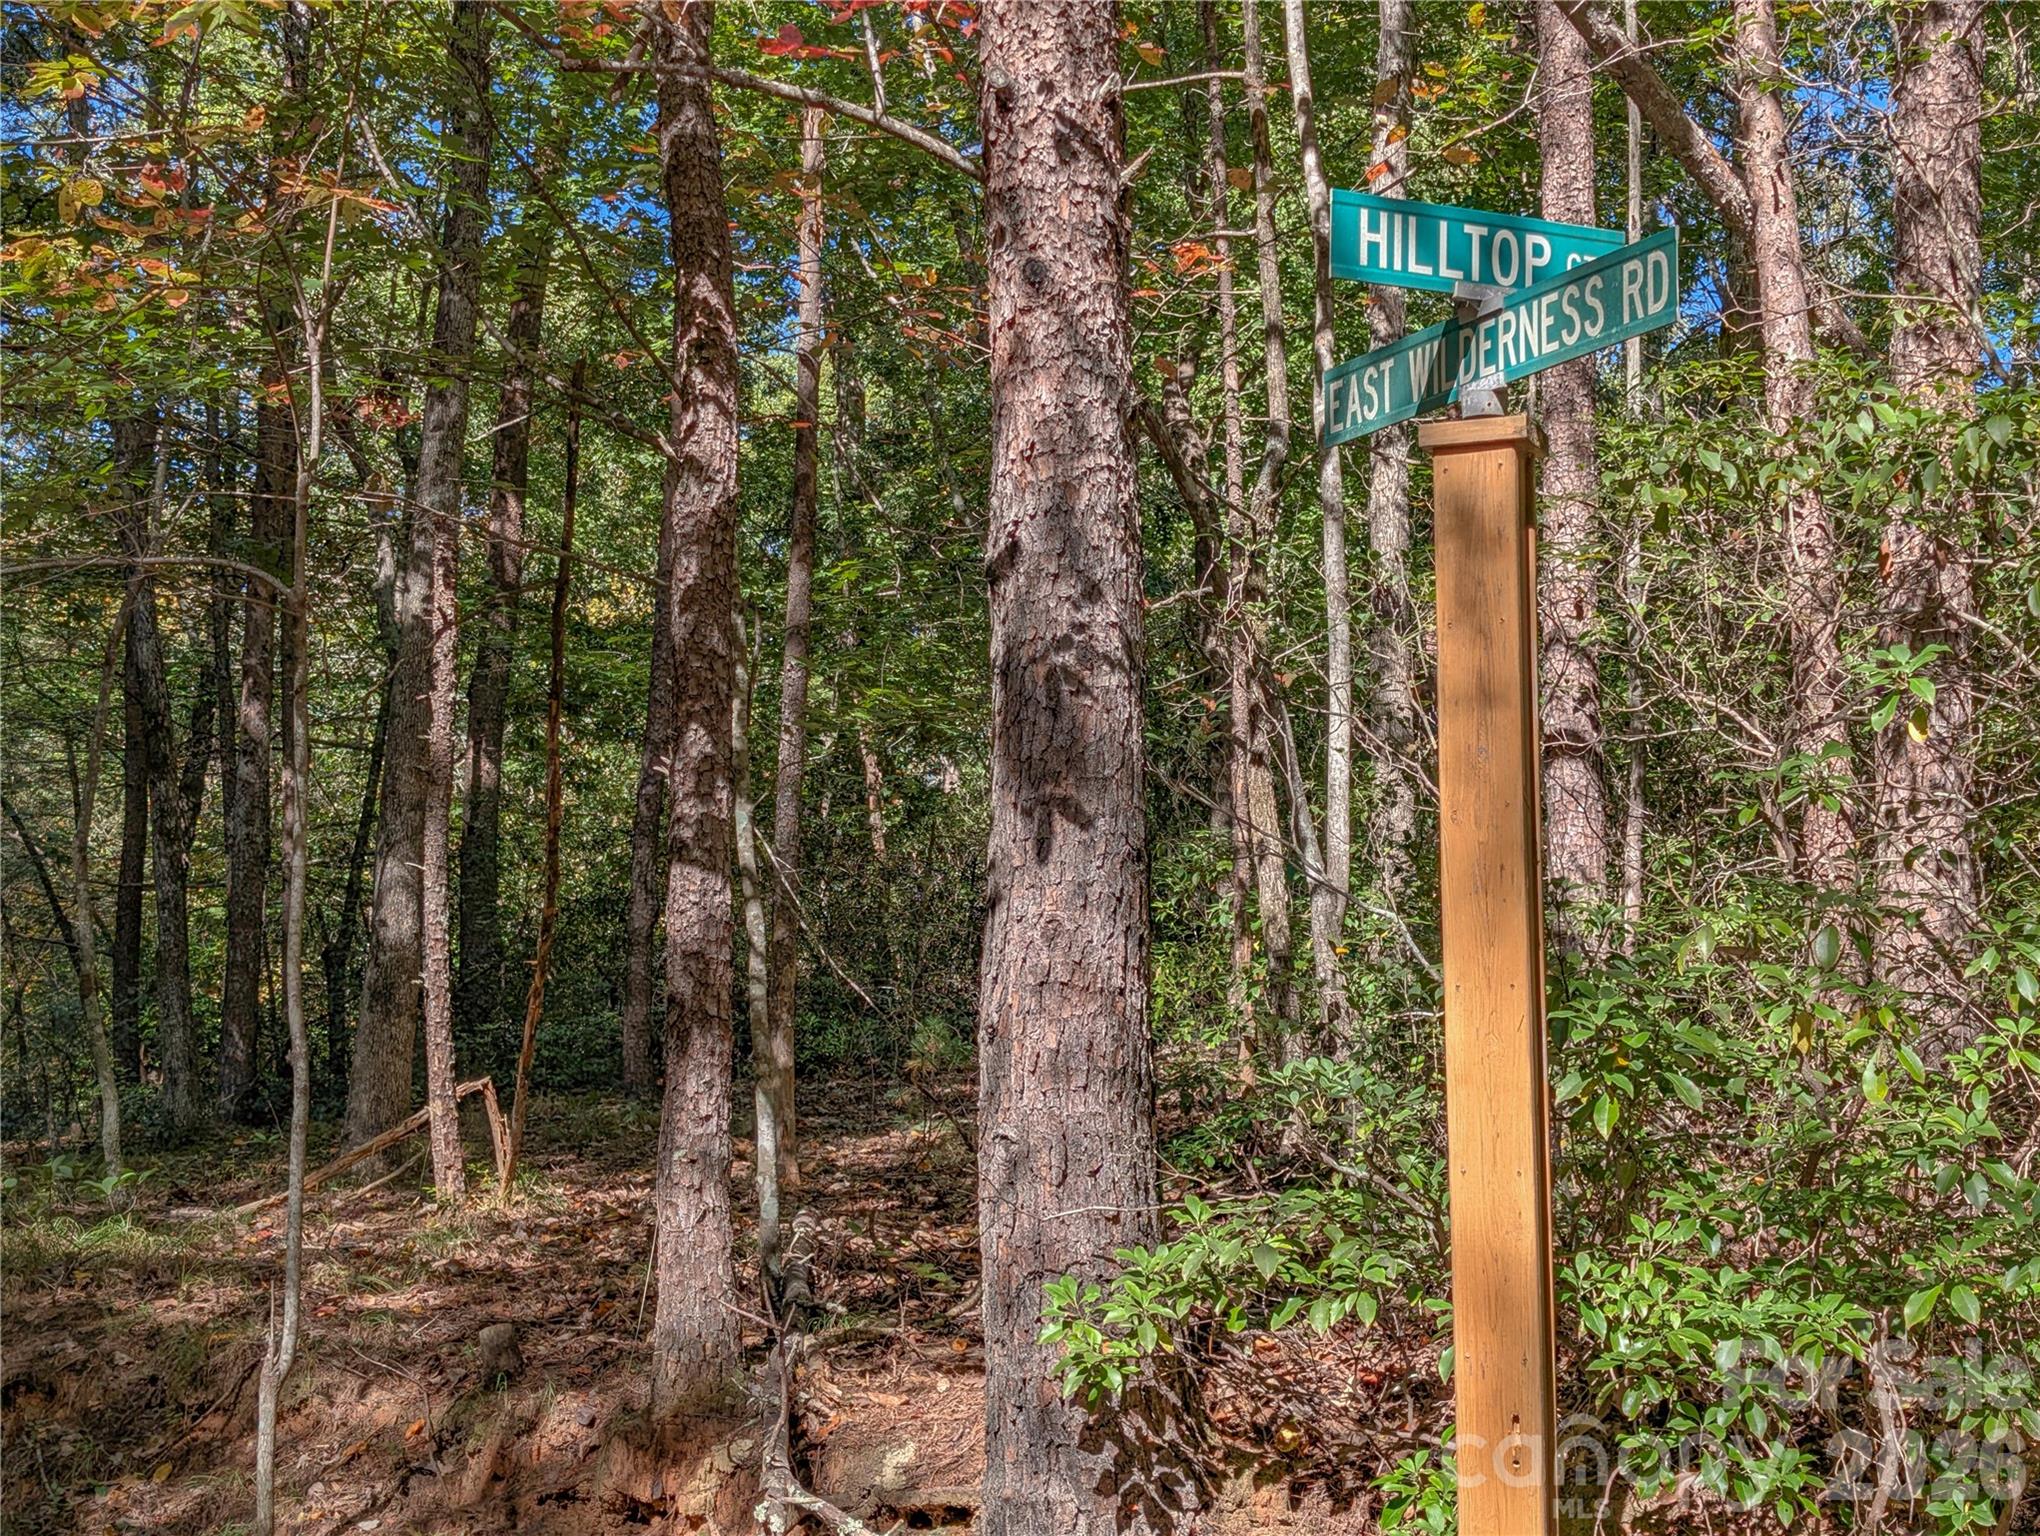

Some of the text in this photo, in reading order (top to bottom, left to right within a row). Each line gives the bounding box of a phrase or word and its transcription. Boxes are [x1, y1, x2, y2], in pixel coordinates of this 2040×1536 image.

[1359, 208, 1552, 288] HILLTOP
[1329, 250, 1670, 435] EAST WILDERNESS RD
